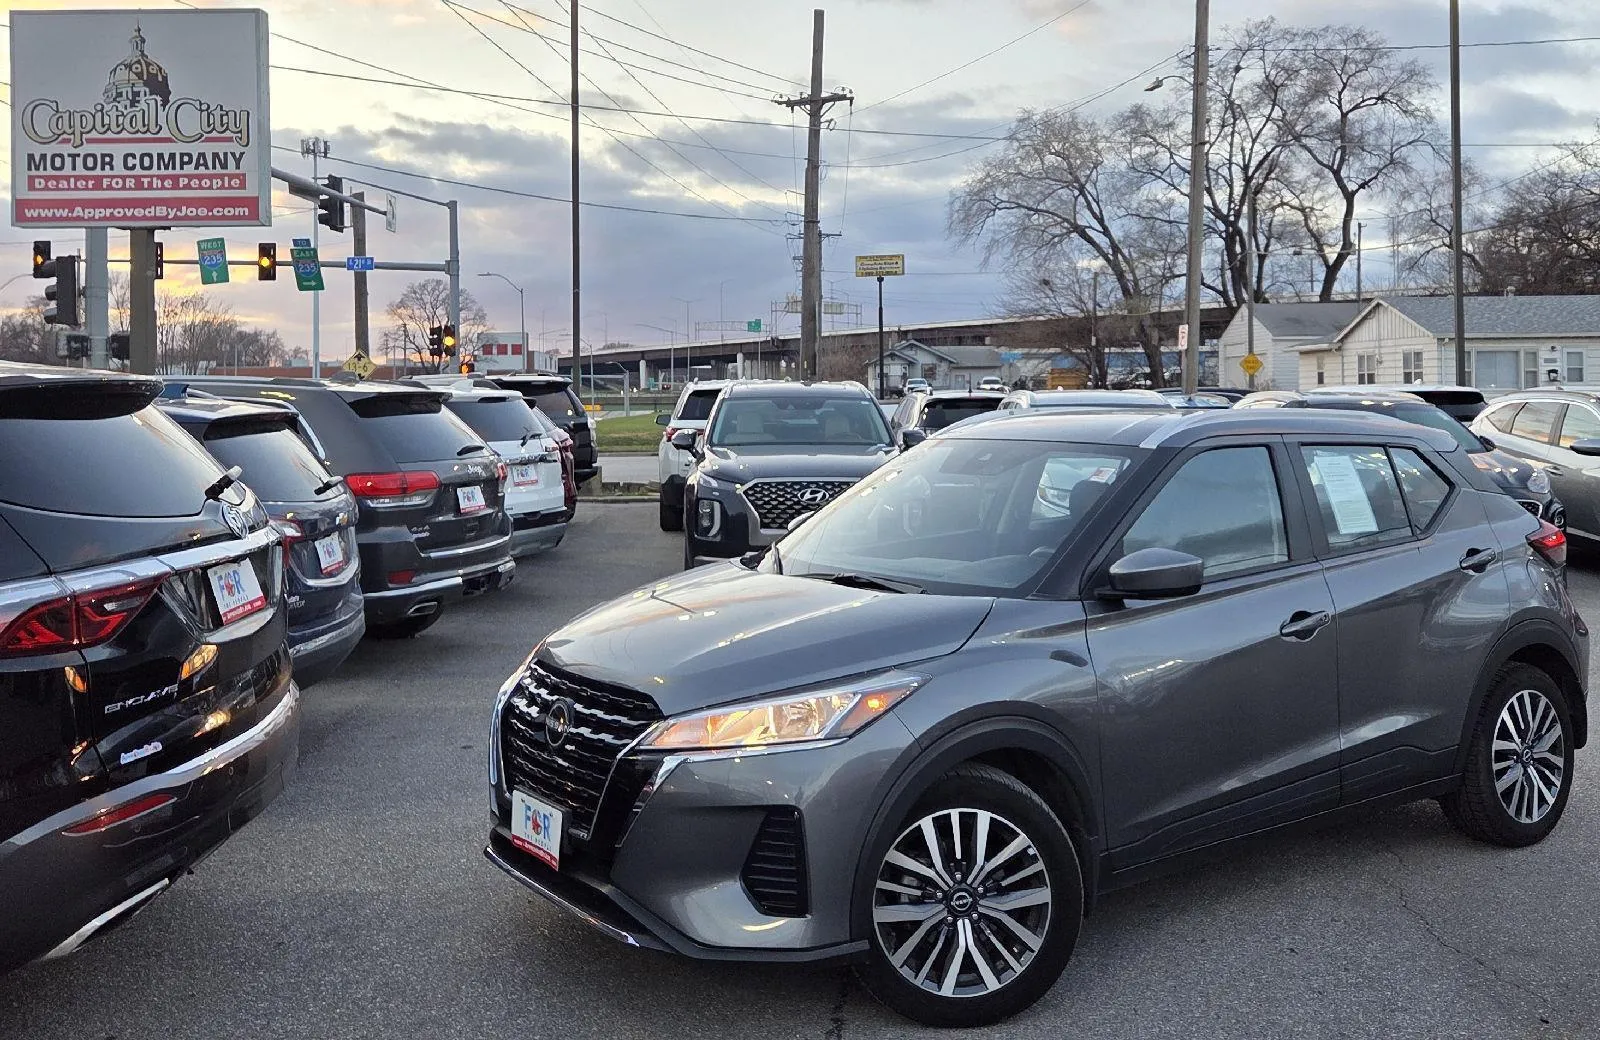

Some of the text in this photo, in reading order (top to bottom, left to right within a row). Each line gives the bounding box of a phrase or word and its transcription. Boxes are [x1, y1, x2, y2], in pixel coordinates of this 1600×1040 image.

[22, 97, 249, 148] Capital City
[27, 151, 245, 171] MOTOR COMPANY
[35, 176, 241, 190] Dealer FOR The People
[25, 205, 249, 219] www.ApprovedByJoe.com
[200, 241, 221, 249] WEST
[203, 253, 223, 265] 235
[293, 250, 314, 258] EAST
[298, 263, 317, 273] 235
[468, 464, 482, 476] Jeep
[524, 803, 551, 842] FOR
